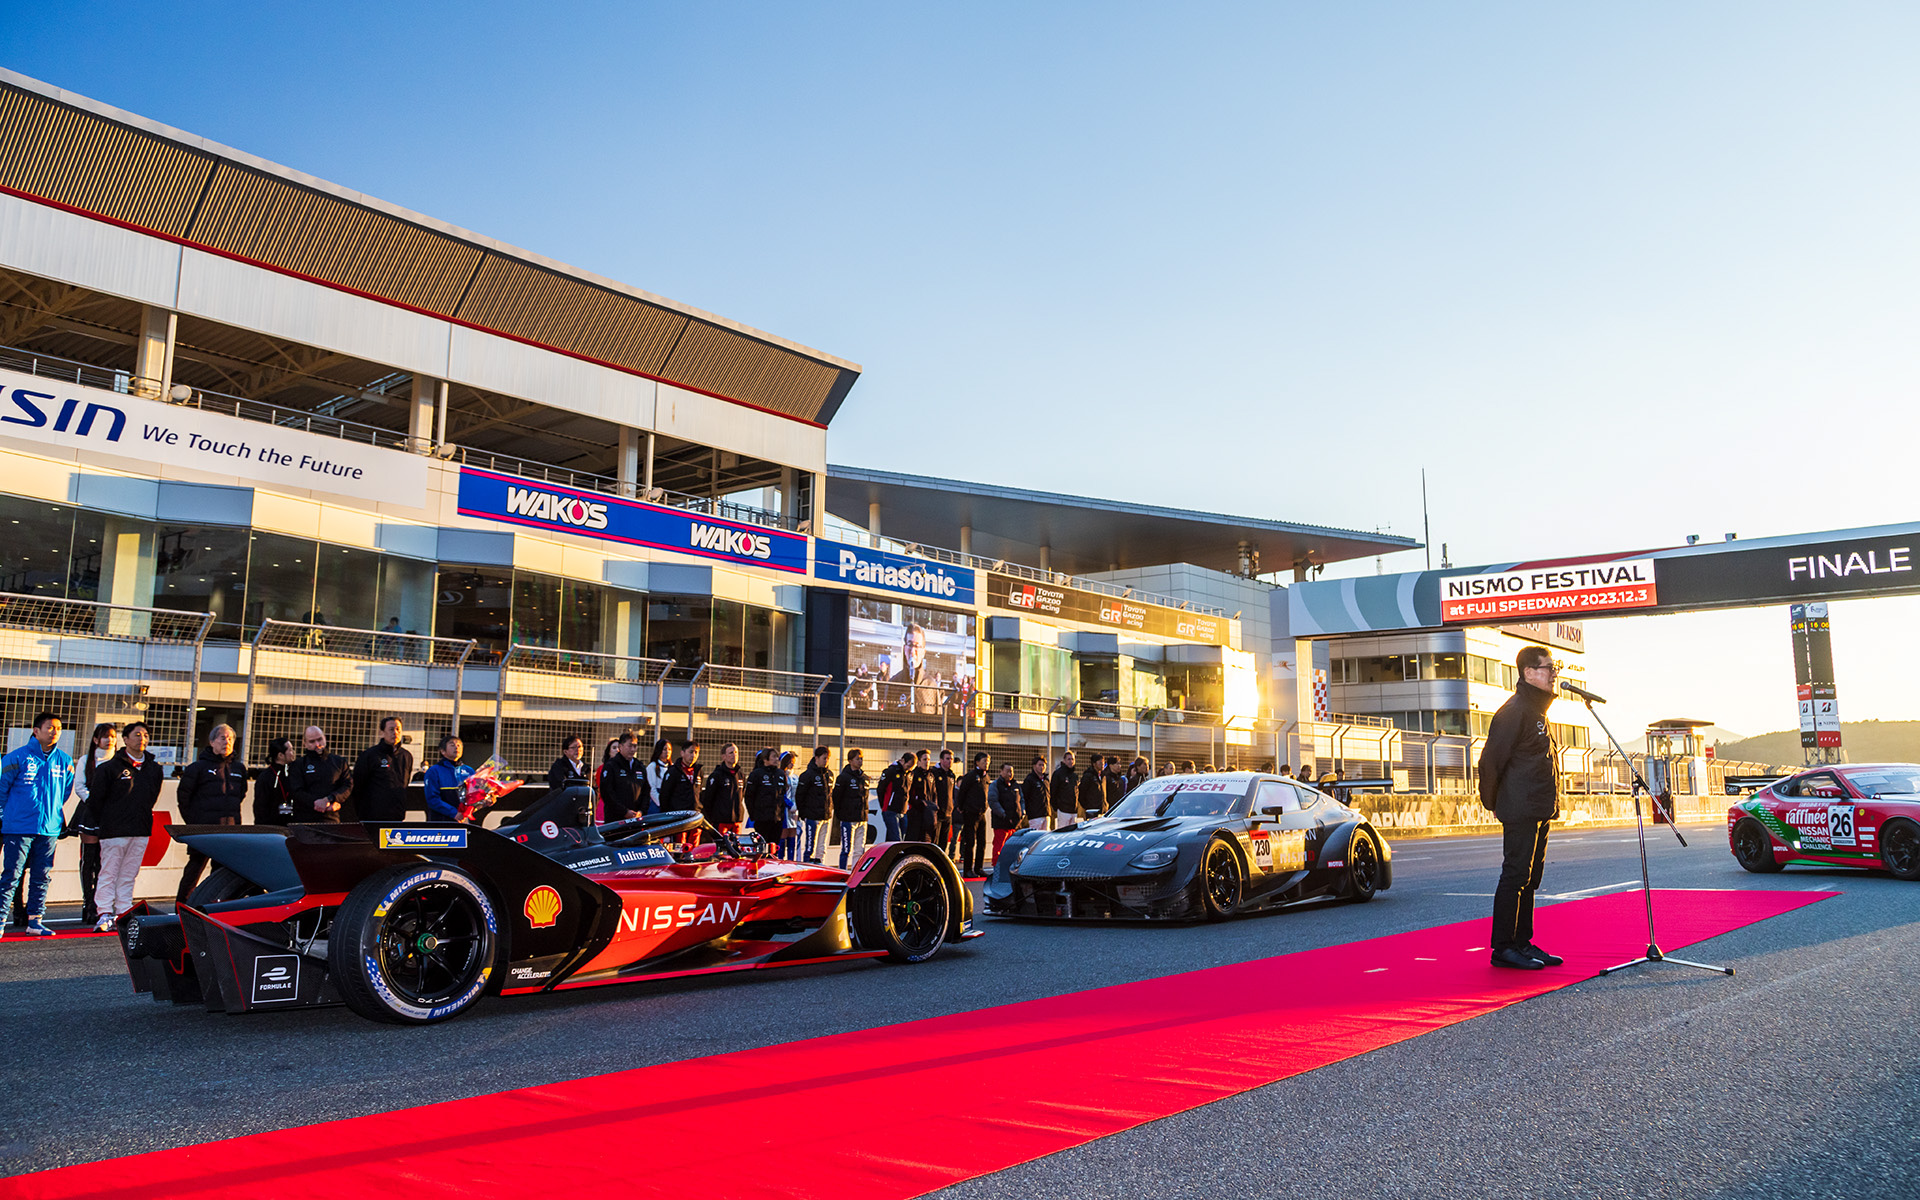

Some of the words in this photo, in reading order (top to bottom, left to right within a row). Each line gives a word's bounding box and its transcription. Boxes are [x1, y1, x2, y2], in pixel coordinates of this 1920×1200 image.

[0, 384, 127, 442] SIN
[142, 424, 179, 445] We
[187, 432, 251, 459] Touch
[257, 447, 293, 466] the
[299, 454, 363, 480] Future
[506, 486, 608, 530] WAKO'S
[690, 522, 771, 559] WAKO'S
[1788, 547, 1912, 581] FINALE
[839, 549, 956, 597] Panasonic
[1449, 576, 1524, 597] NISMO
[1531, 565, 1646, 591] FESTIVAL
[1010, 591, 1034, 607] GR
[1036, 595, 1062, 606] GAZOO
[1037, 587, 1064, 599] TOYOTA
[1035, 602, 1060, 614] Racing
[1123, 604, 1146, 614] TOYOTA
[1449, 604, 1465, 616] at
[1466, 601, 1497, 615] FUJI
[1499, 595, 1578, 612] SPEEDWAY
[1580, 589, 1648, 606] 2023.12.3
[1100, 608, 1121, 622] GR
[1122, 611, 1144, 621] GAZOO
[1162, 783, 1227, 792] BOSCH
[1371, 812, 1429, 827] ADVAN
[1456, 803, 1498, 825] YOKOHA
[1785, 808, 1827, 825] raffinée
[1797, 826, 1829, 836] NISSAN
[1830, 813, 1852, 837] 26
[405, 835, 460, 843] MICHELIN
[1043, 831, 1146, 842] NIAN
[1800, 836, 1831, 844] MECHANIC
[617, 850, 648, 865] Julius
[648, 847, 666, 859] Bär
[1254, 840, 1271, 856] 230
[389, 871, 438, 901] MICHELIN
[616, 900, 741, 934] NISSAN
[260, 983, 287, 991] FORMULA
[433, 984, 480, 1017] MICHELIN
